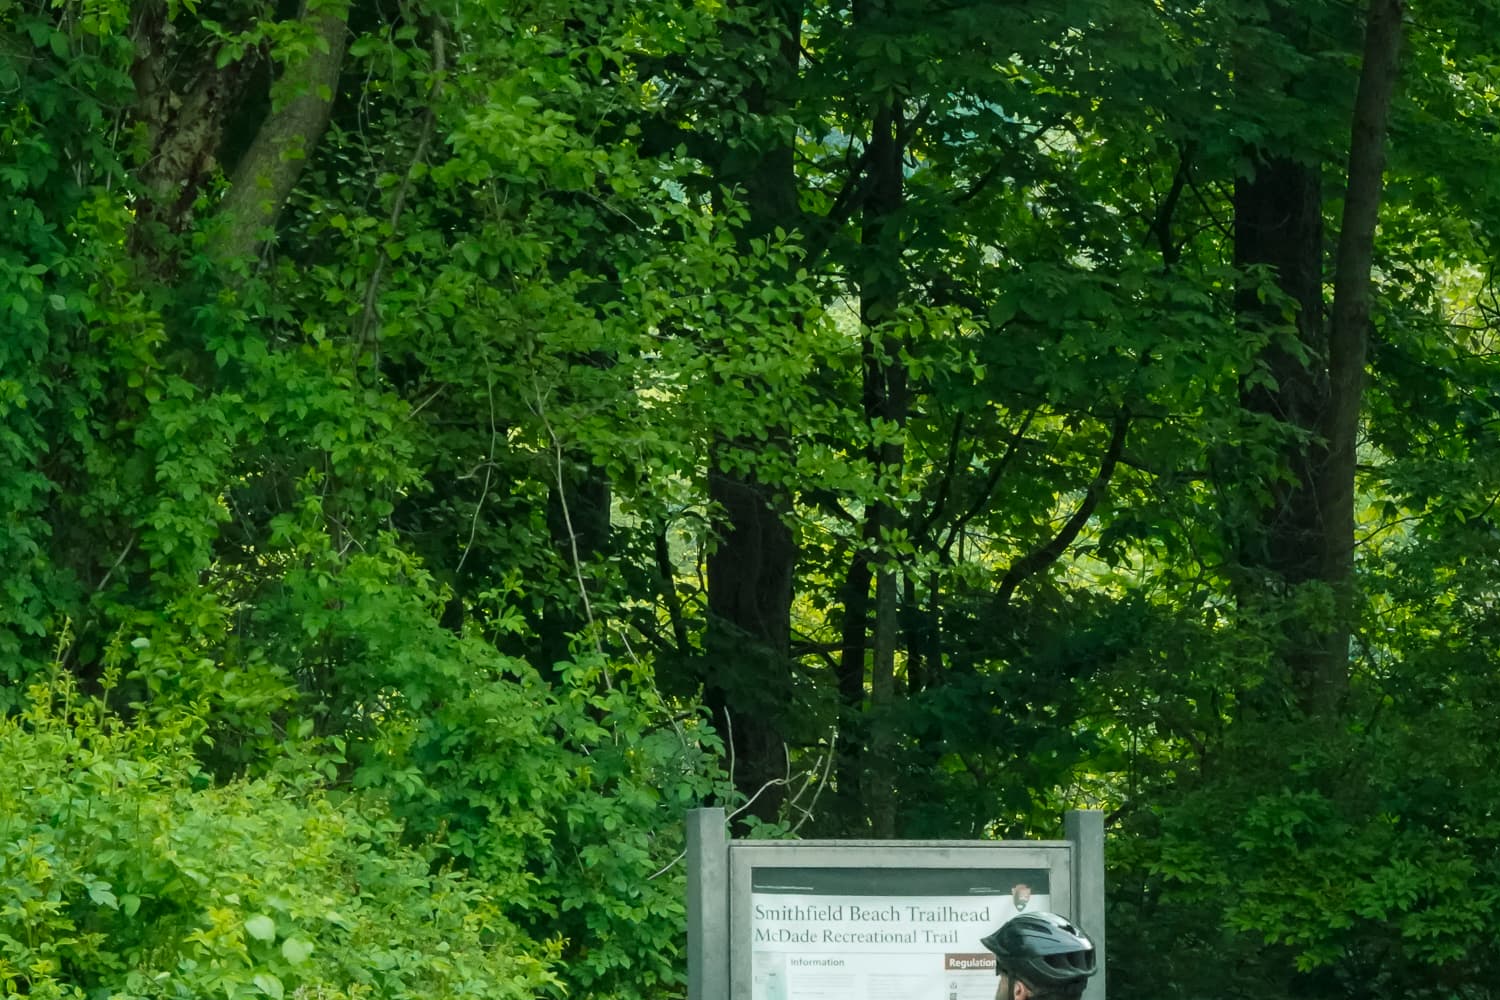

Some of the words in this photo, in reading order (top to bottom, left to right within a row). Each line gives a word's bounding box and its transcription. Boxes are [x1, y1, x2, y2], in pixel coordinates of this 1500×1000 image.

[755, 904, 843, 921] Smithfield
[849, 905, 901, 921] Beach
[906, 905, 990, 922] Trailhead
[755, 928, 817, 943] McDade
[823, 929, 916, 943] Recreational
[924, 930, 958, 943] Trail
[791, 958, 845, 966] Information
